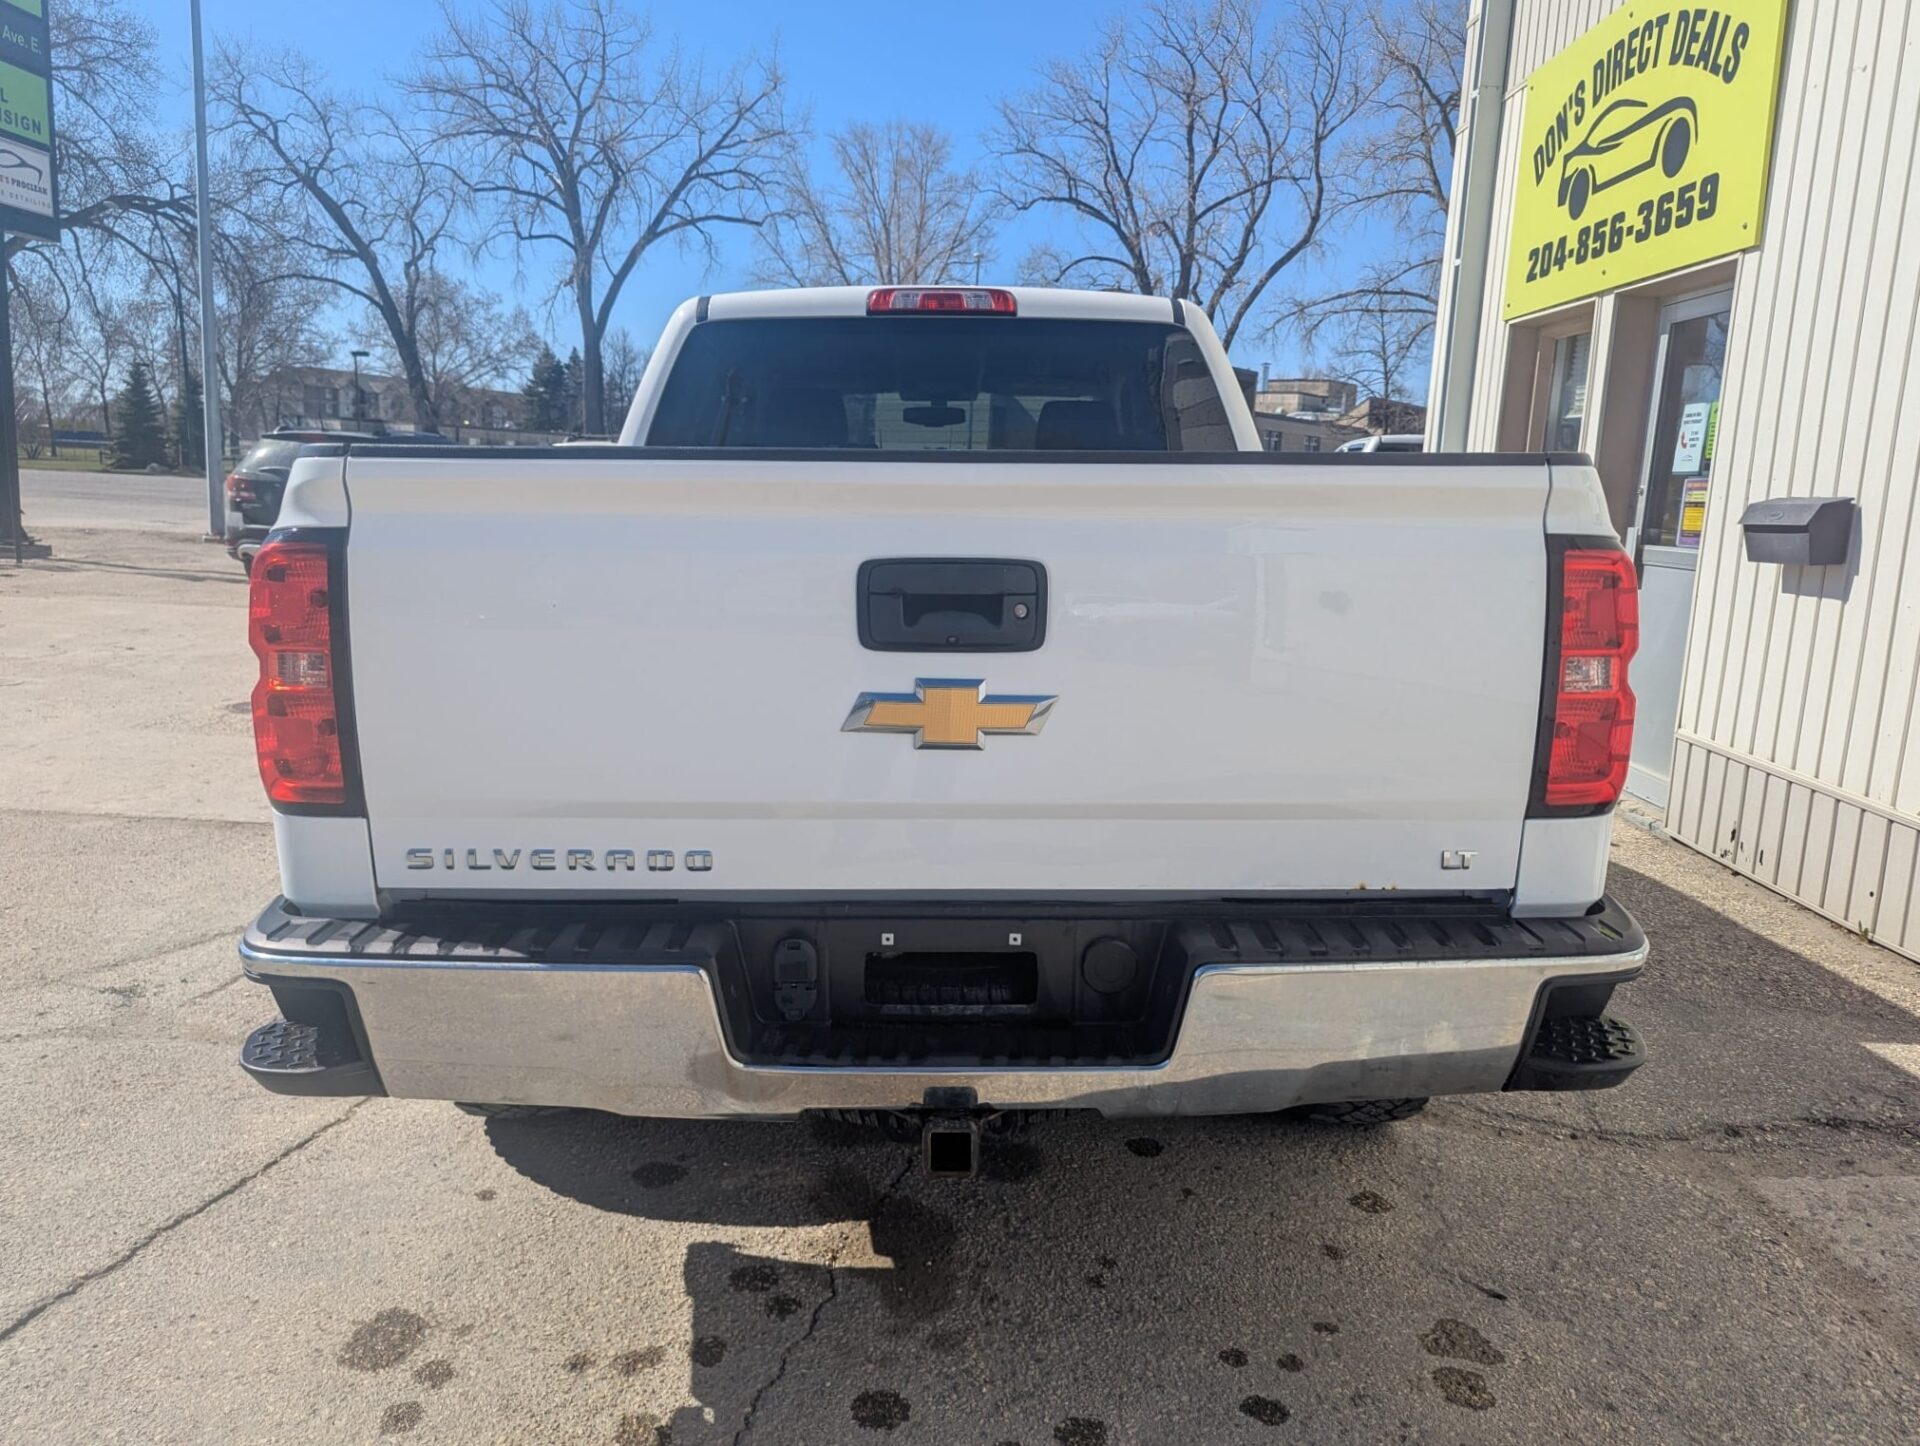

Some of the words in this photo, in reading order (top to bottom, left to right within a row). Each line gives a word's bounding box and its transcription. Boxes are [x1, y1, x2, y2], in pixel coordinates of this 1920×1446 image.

[2, 24, 28, 48] Ave.
[31, 36, 42, 55] E.
[1533, 79, 1586, 187] DON'S
[1592, 12, 1670, 108] DIRECT
[1668, 8, 1750, 84] DEALS
[0, 107, 42, 135] SIGN
[1526, 172, 1720, 283] 204-856-3659
[406, 848, 713, 872] SILVERADO
[1441, 850, 1479, 870] LT
